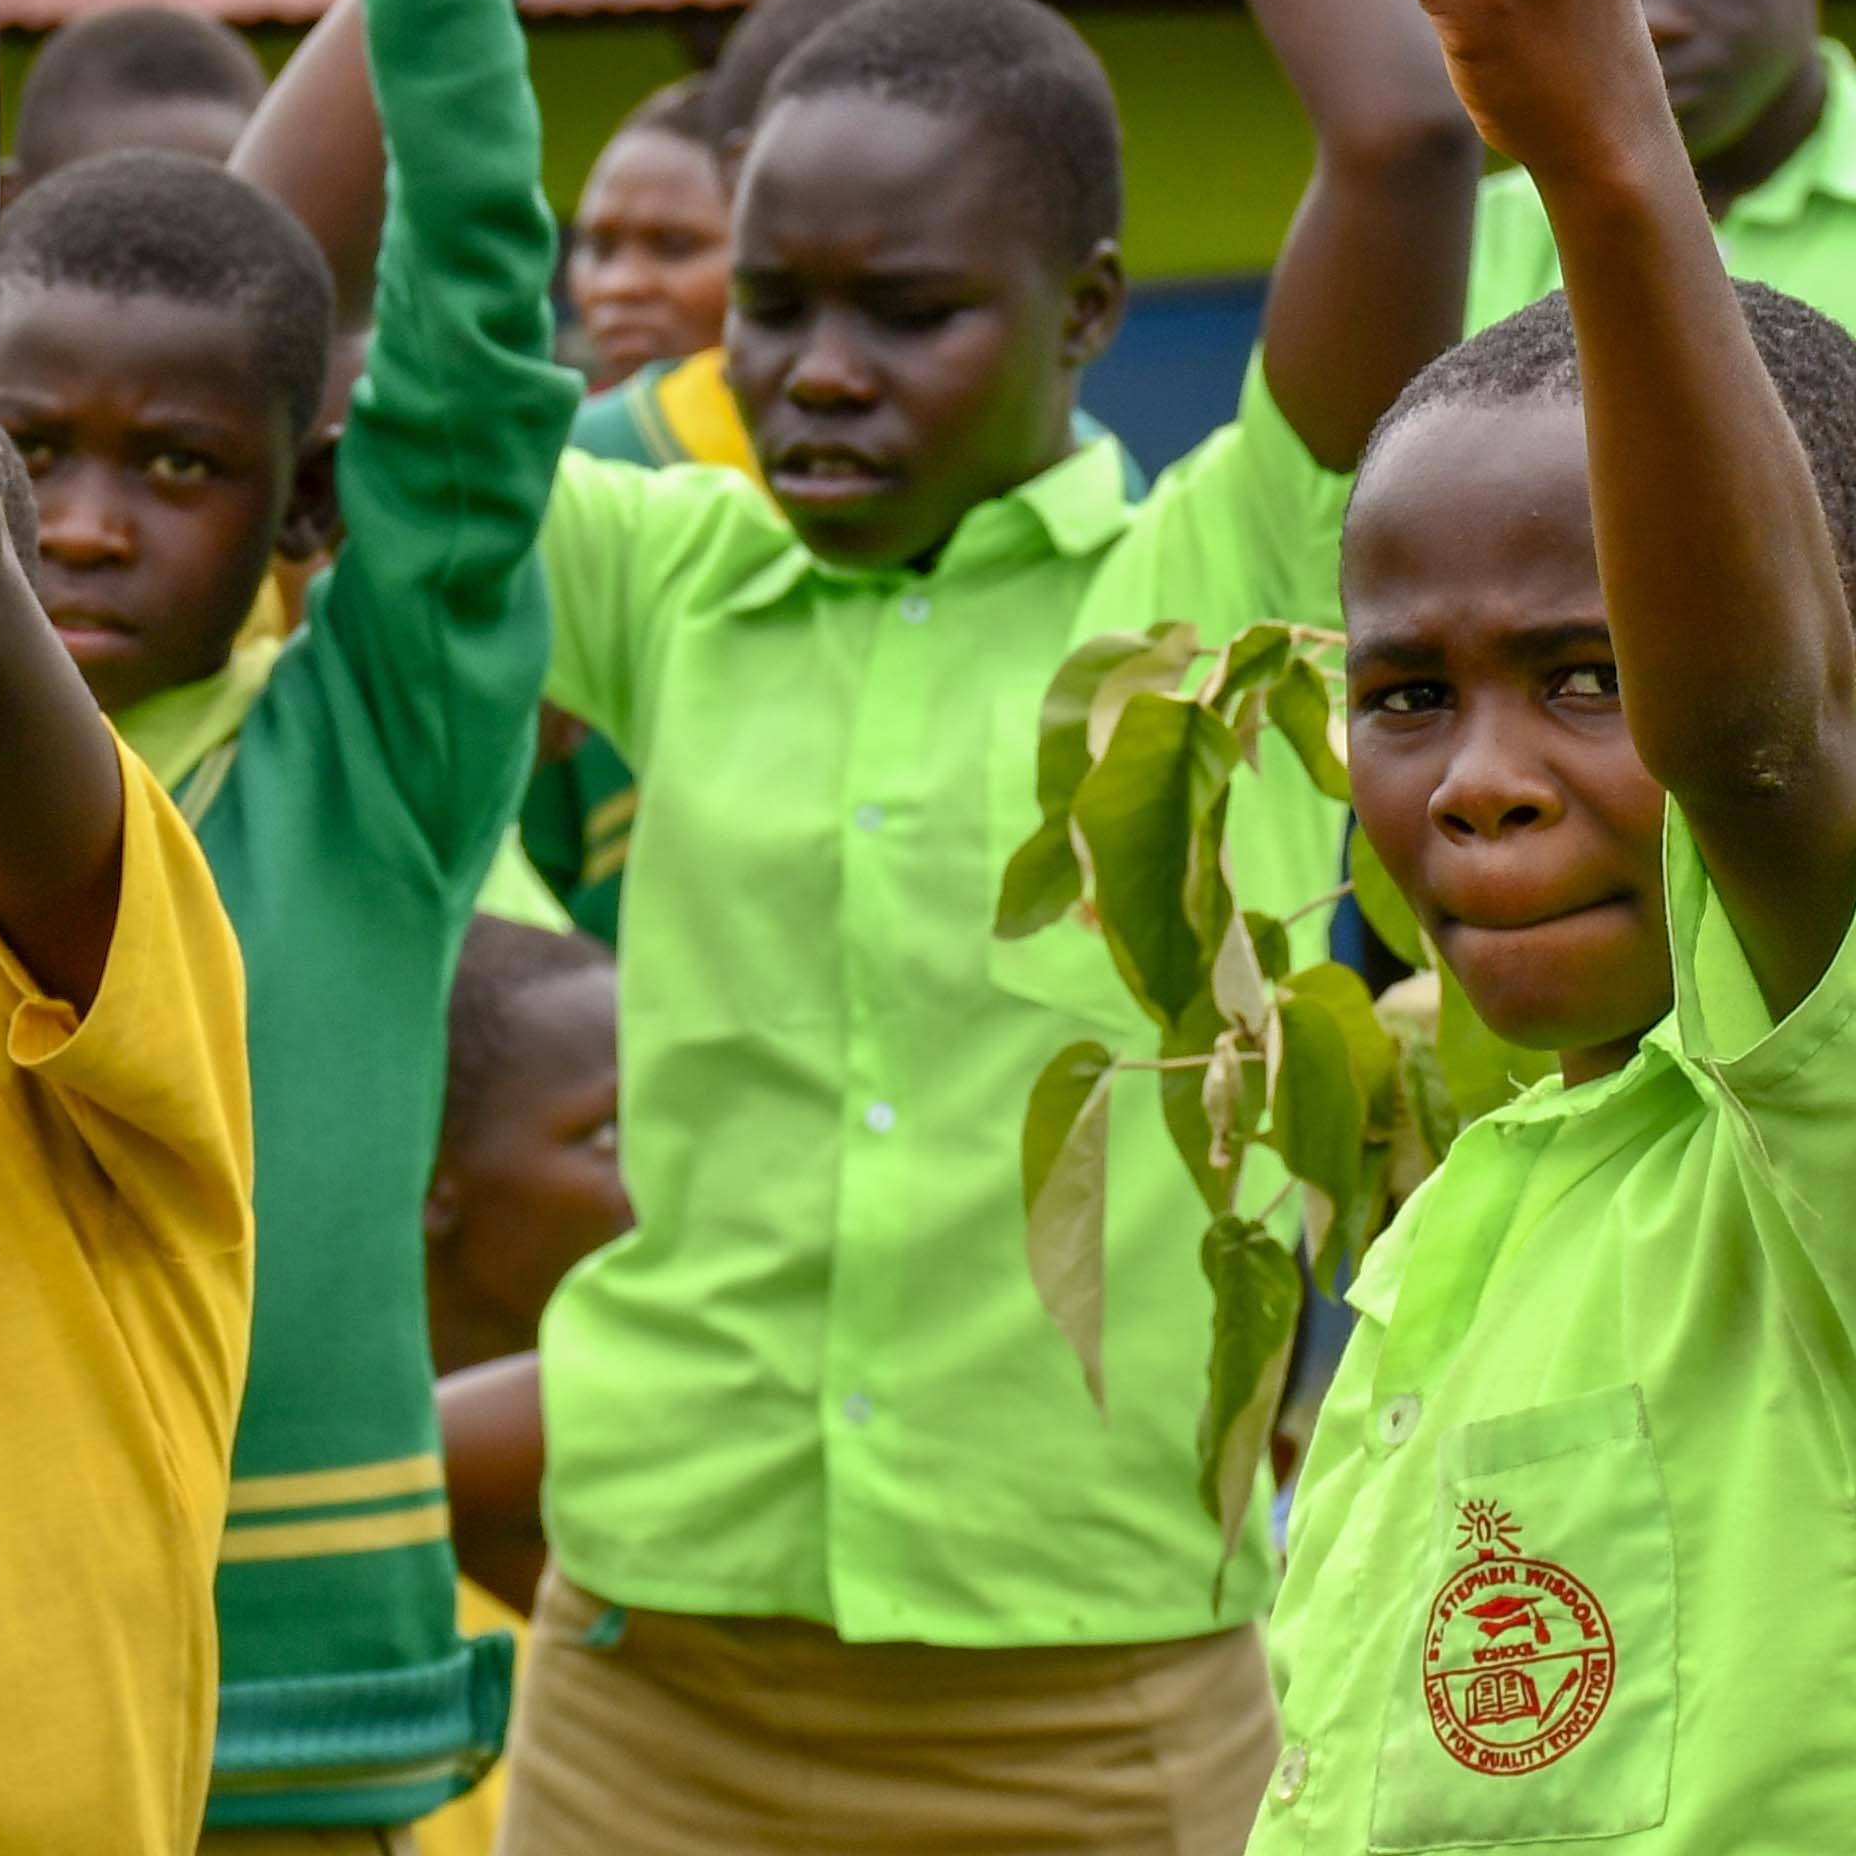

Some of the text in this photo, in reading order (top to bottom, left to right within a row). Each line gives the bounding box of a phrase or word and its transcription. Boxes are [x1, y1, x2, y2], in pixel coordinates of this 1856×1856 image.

[1440, 1565, 1517, 1623] STEPHEN
[1525, 1566, 1602, 1641] WISDOM
[1473, 1641, 1539, 1664] SCHOOL
[1428, 1658, 1608, 1769] LIGHT FOR QUALITY EDUCATION
